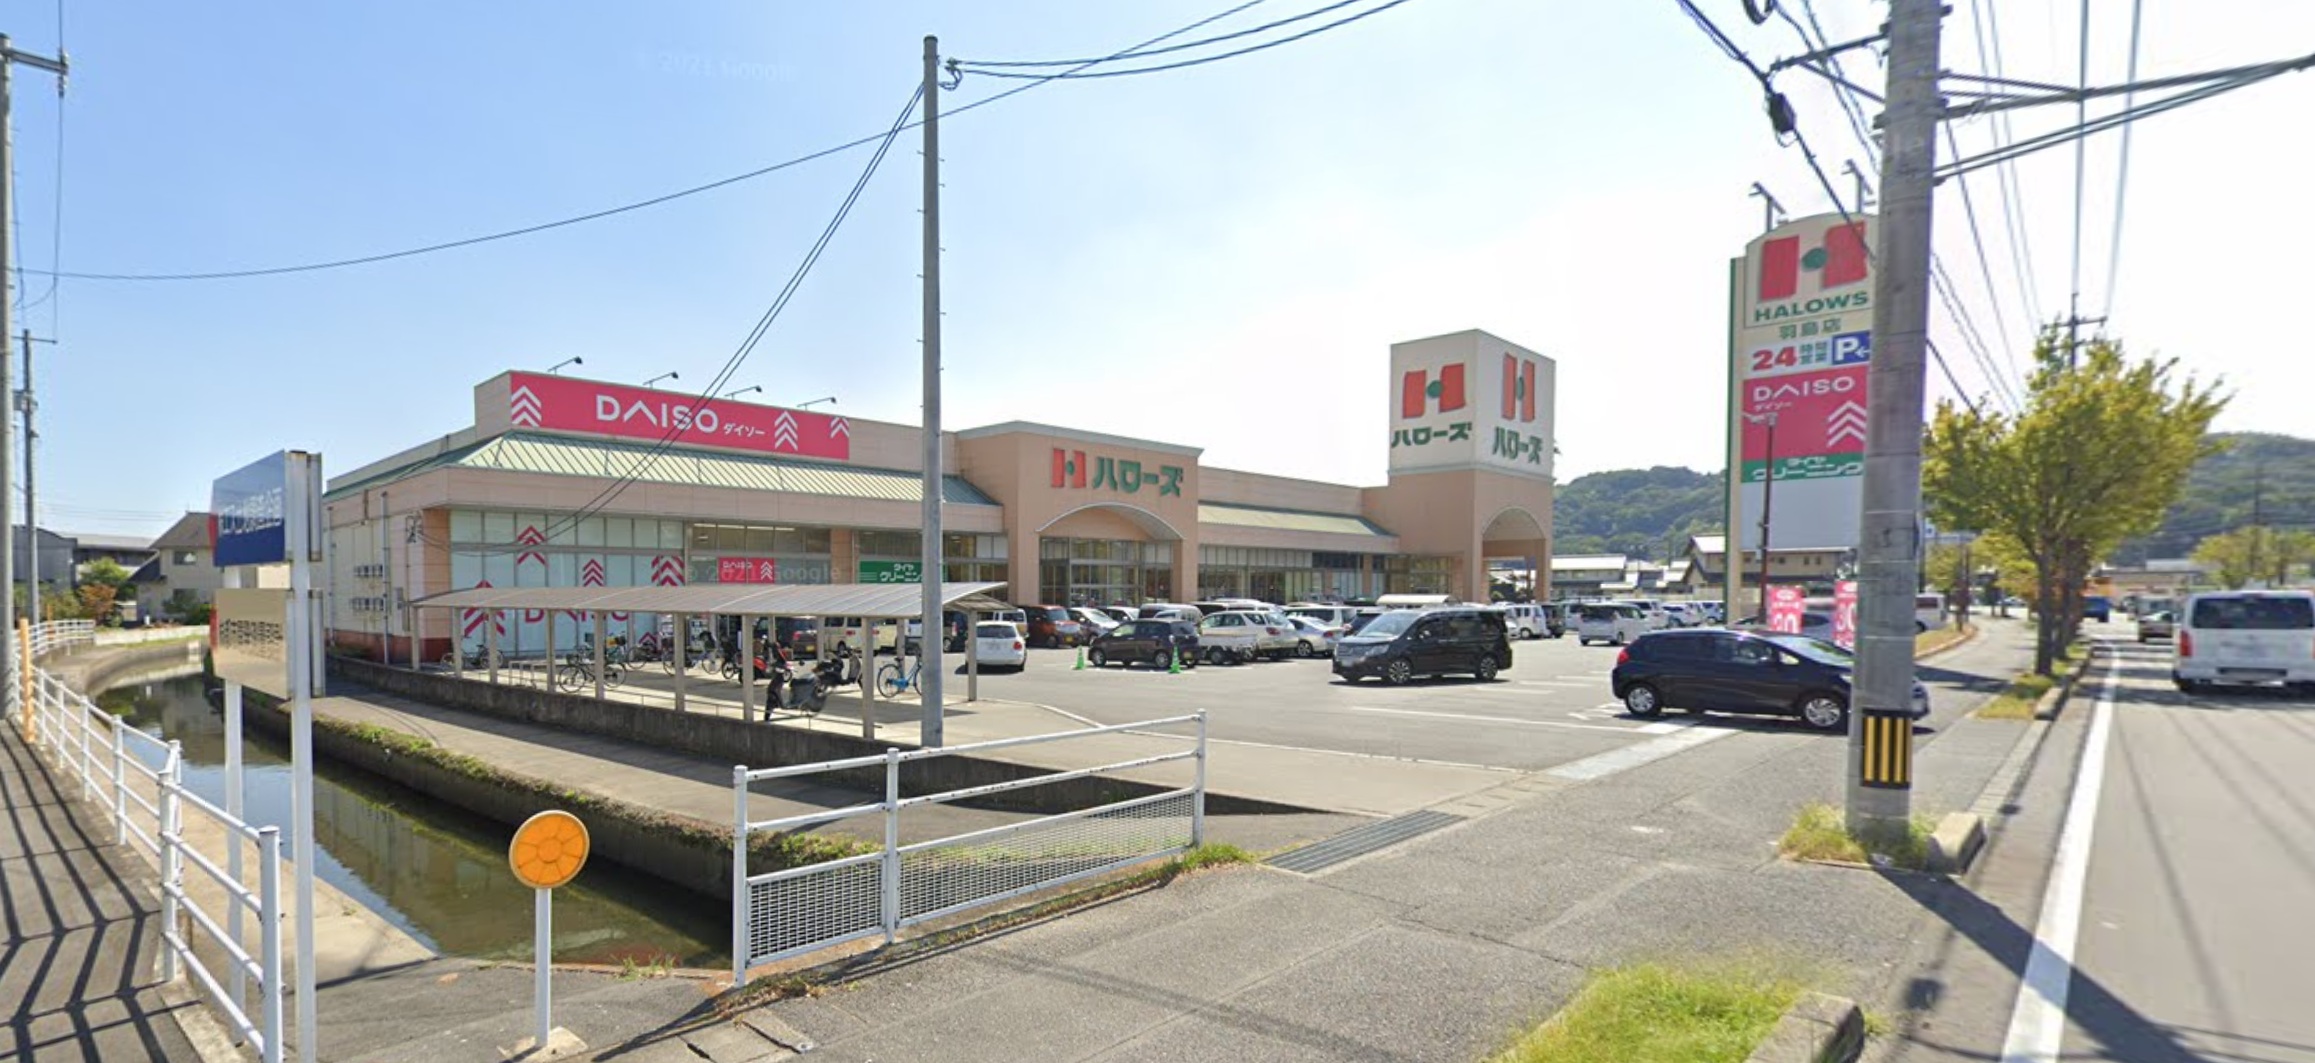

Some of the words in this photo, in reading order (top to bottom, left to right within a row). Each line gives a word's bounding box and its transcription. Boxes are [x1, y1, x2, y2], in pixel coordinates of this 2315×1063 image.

[1754, 291, 1869, 322] HALOWS
[1752, 345, 1798, 371] 24
[1834, 338, 1859, 362] P
[1753, 375, 1856, 402] DAISO
[595, 394, 720, 434] DAISO
[723, 422, 766, 438] ダイソー
[1390, 421, 1473, 449] ハローズ
[1492, 426, 1543, 465] ハローズ
[1092, 456, 1184, 498] ハローズ
[879, 571, 924, 582] クリーニン
